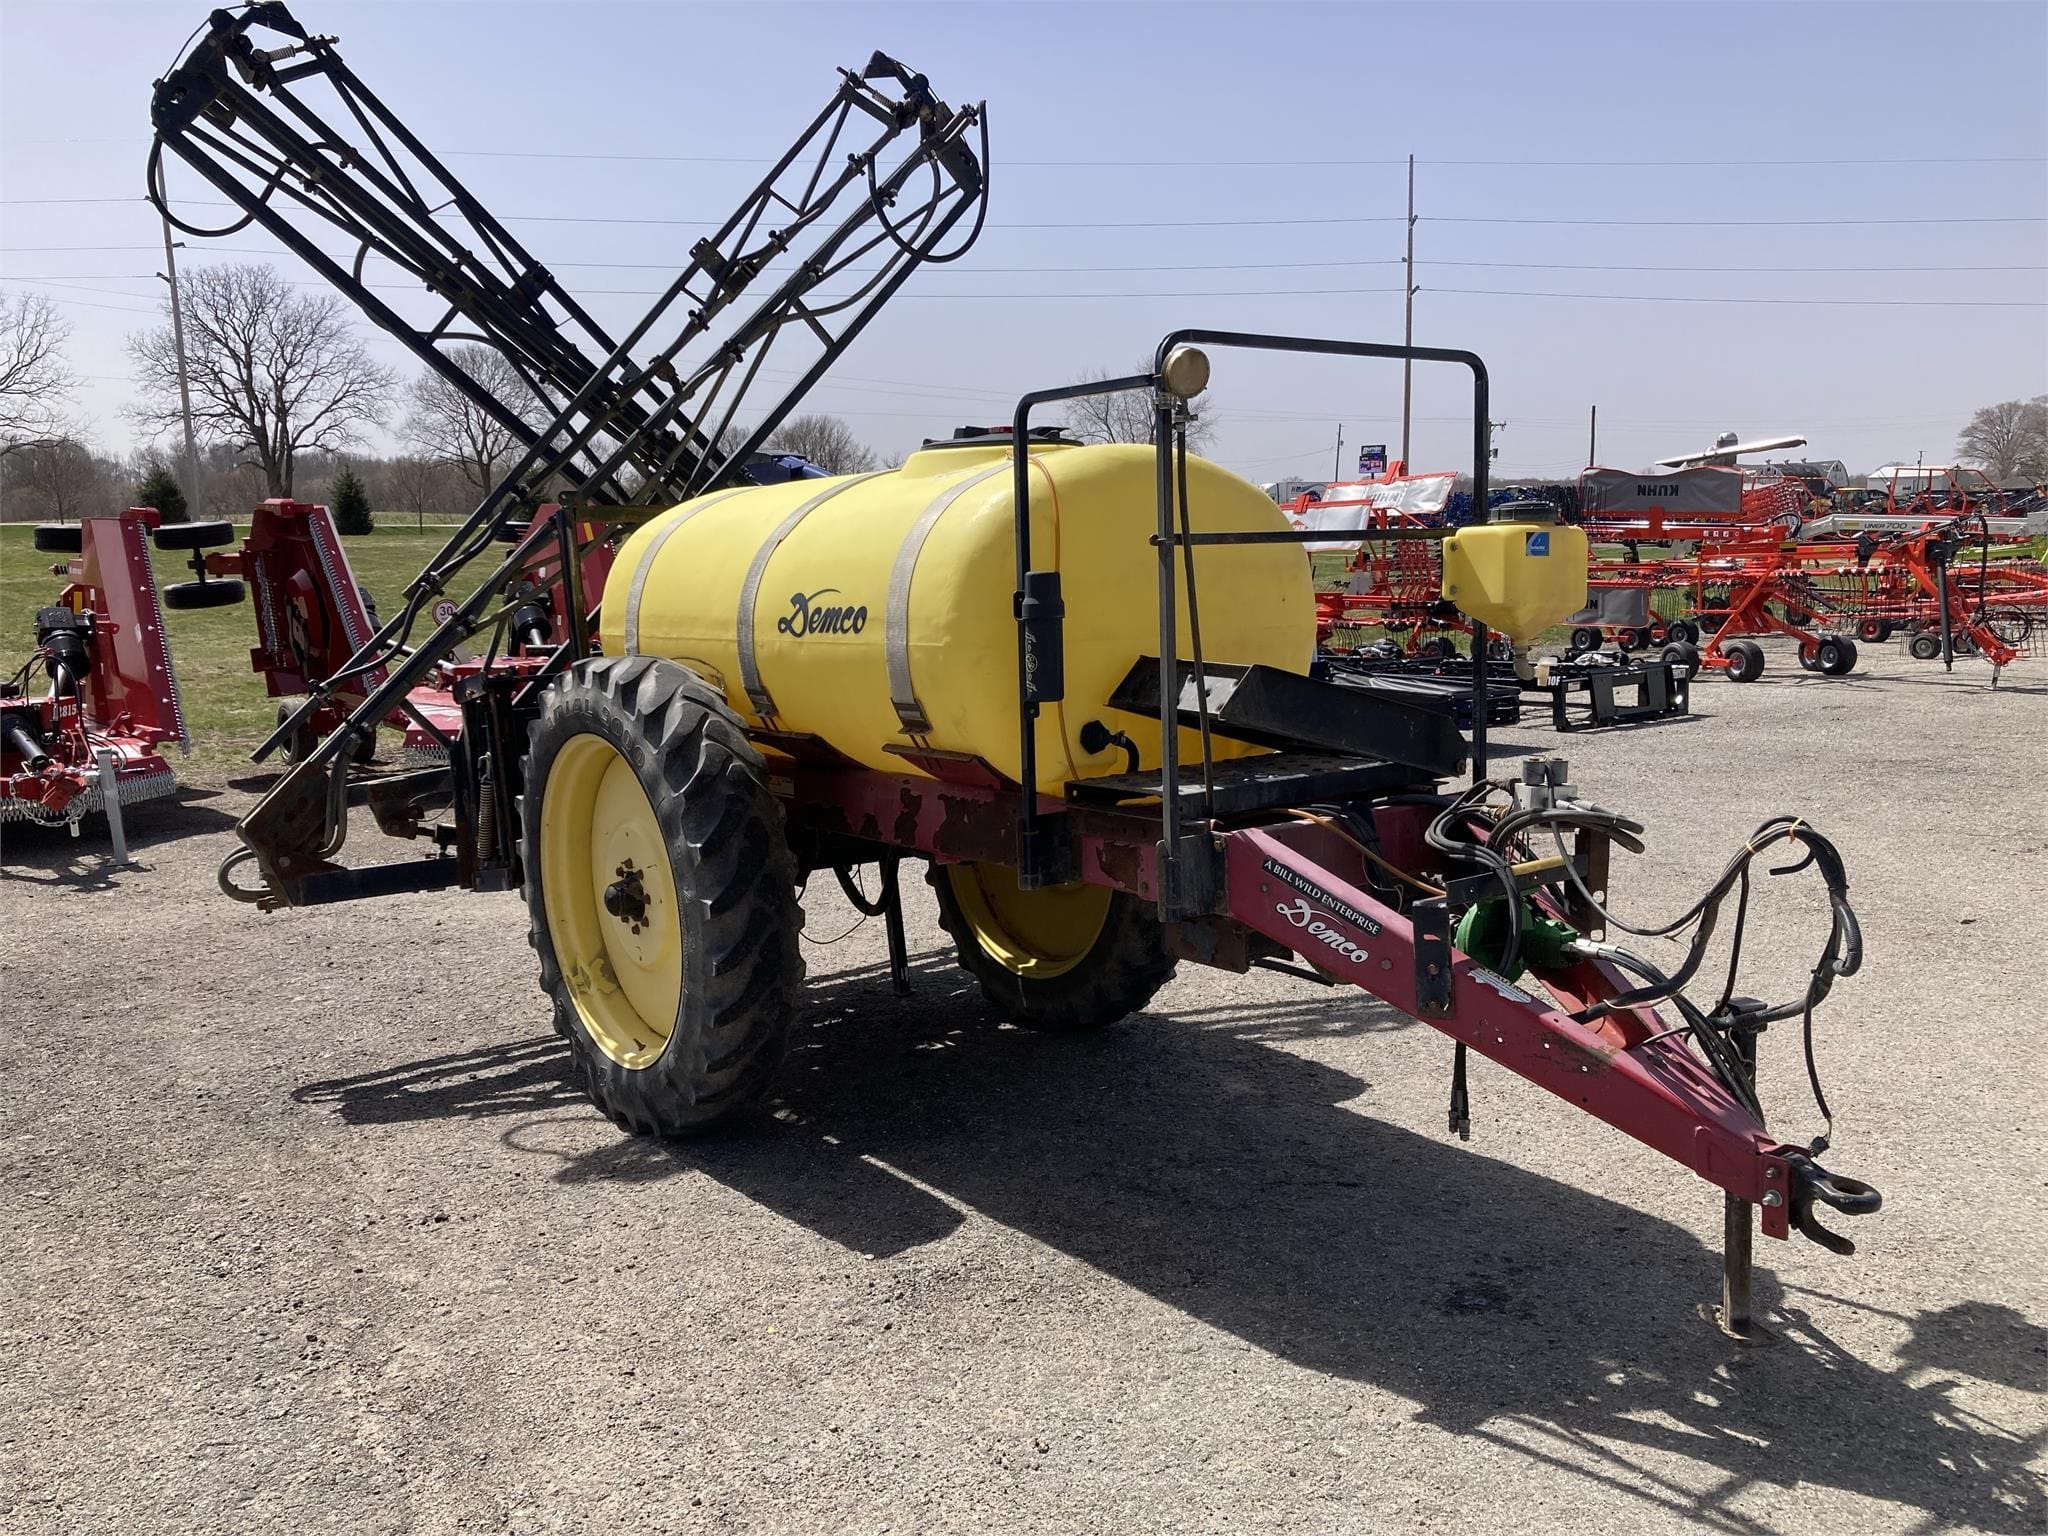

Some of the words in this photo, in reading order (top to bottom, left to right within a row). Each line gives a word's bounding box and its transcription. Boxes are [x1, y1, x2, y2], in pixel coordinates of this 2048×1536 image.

[1637, 484, 1679, 497] KUHN
[1886, 522, 1908, 530] 700
[440, 606, 453, 616] 30
[777, 588, 868, 638] Demco
[1264, 860, 1272, 870] A
[1273, 865, 1293, 883] BILL
[1295, 876, 1321, 899] WILD
[1321, 895, 1381, 936] ENTERPRISE
[1276, 898, 1369, 963] Demco
